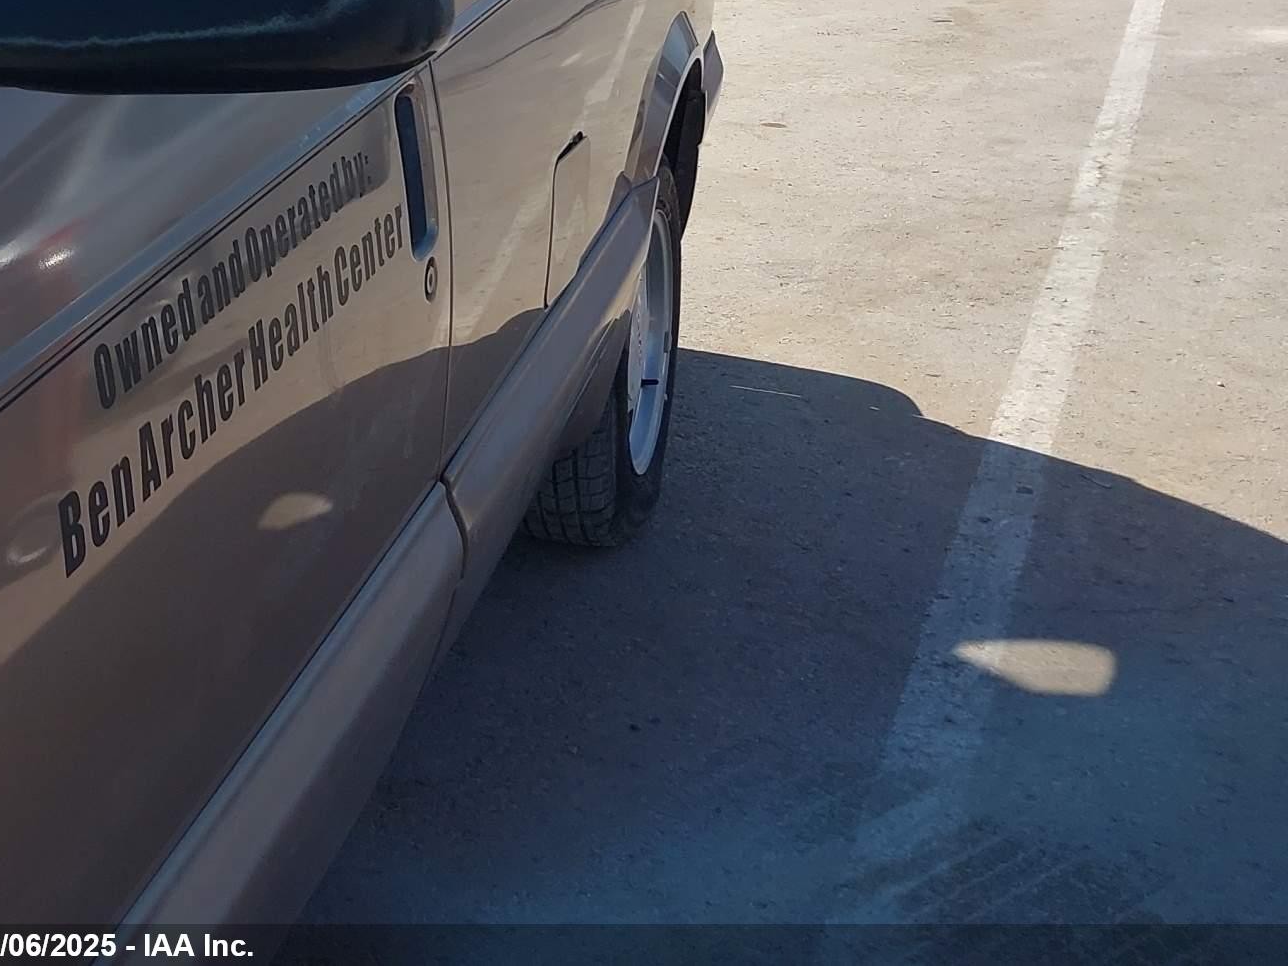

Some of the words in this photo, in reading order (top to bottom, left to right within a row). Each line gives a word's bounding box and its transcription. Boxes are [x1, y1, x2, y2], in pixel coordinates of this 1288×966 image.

[57, 450, 136, 579] Ben
[137, 351, 247, 502] Archer
[247, 265, 335, 391] Health
[333, 202, 403, 307] Center
[93, 278, 196, 410] Owned
[197, 239, 246, 325] and
[245, 161, 344, 284] Operated
